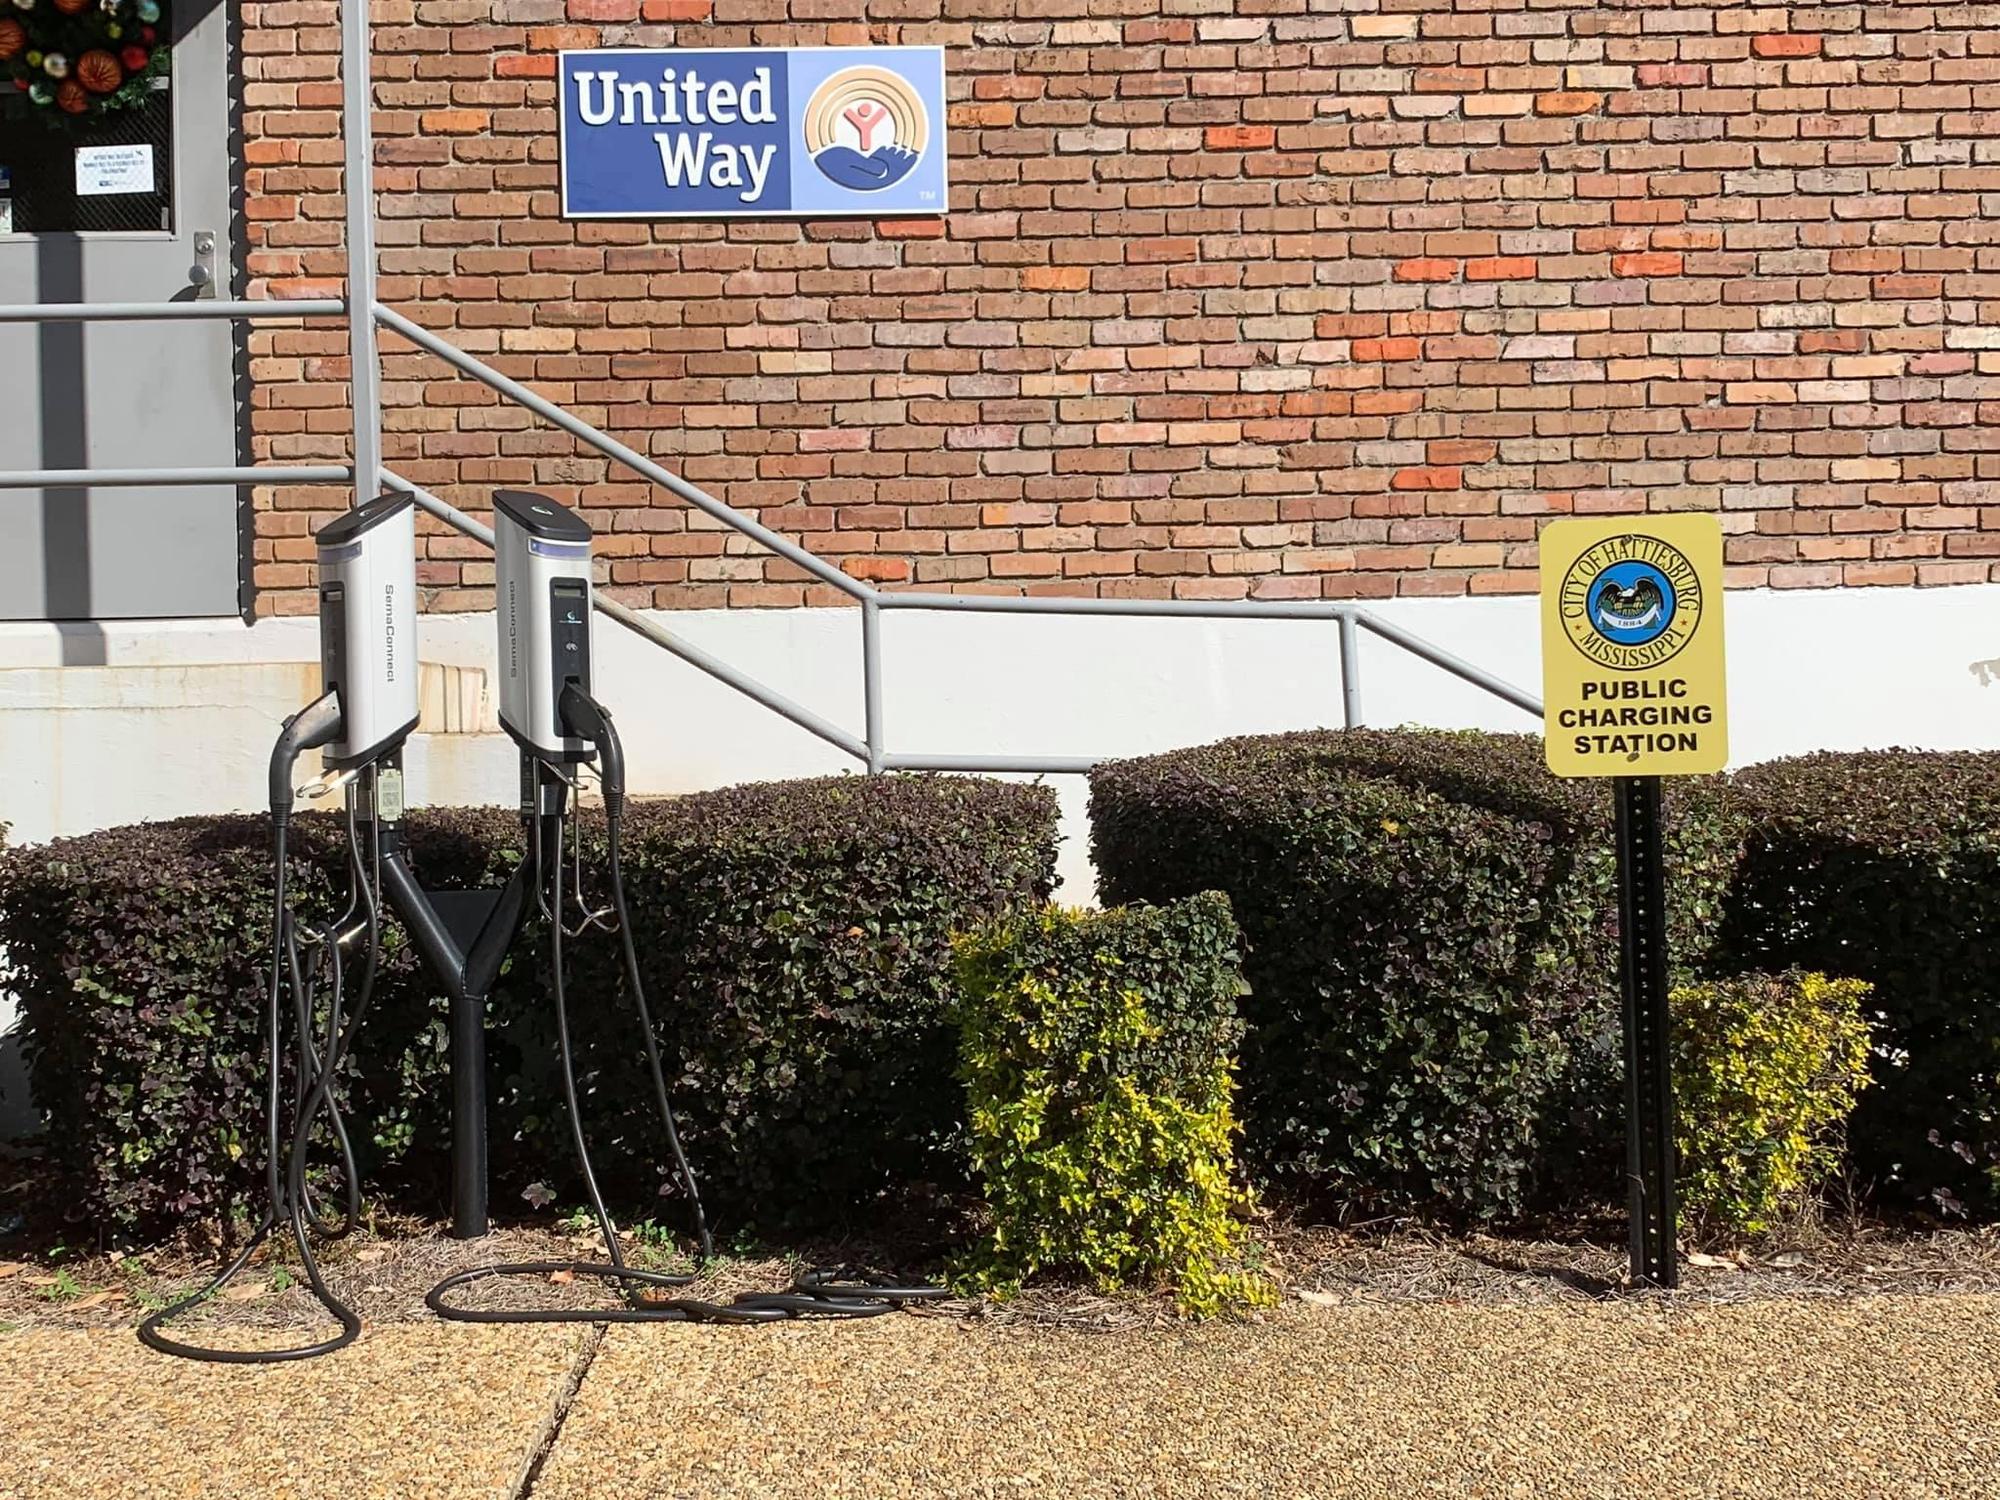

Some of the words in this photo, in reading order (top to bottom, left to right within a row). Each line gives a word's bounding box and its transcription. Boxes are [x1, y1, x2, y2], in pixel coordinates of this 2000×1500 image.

[573, 67, 777, 125] United
[653, 132, 777, 202] Way
[919, 191, 936, 200] TM
[1563, 573, 1588, 618] CITY
[1577, 551, 1602, 577] OF
[1601, 538, 1699, 611] HATTIESBURG
[385, 584, 395, 682] SemaConnect
[509, 581, 517, 678] SemaConnect
[1579, 628, 1686, 667] MISSISSIPPI
[1581, 679, 1688, 701] PUBLIC
[1558, 705, 1712, 728] CHARGING
[1574, 733, 1698, 754] STATION
